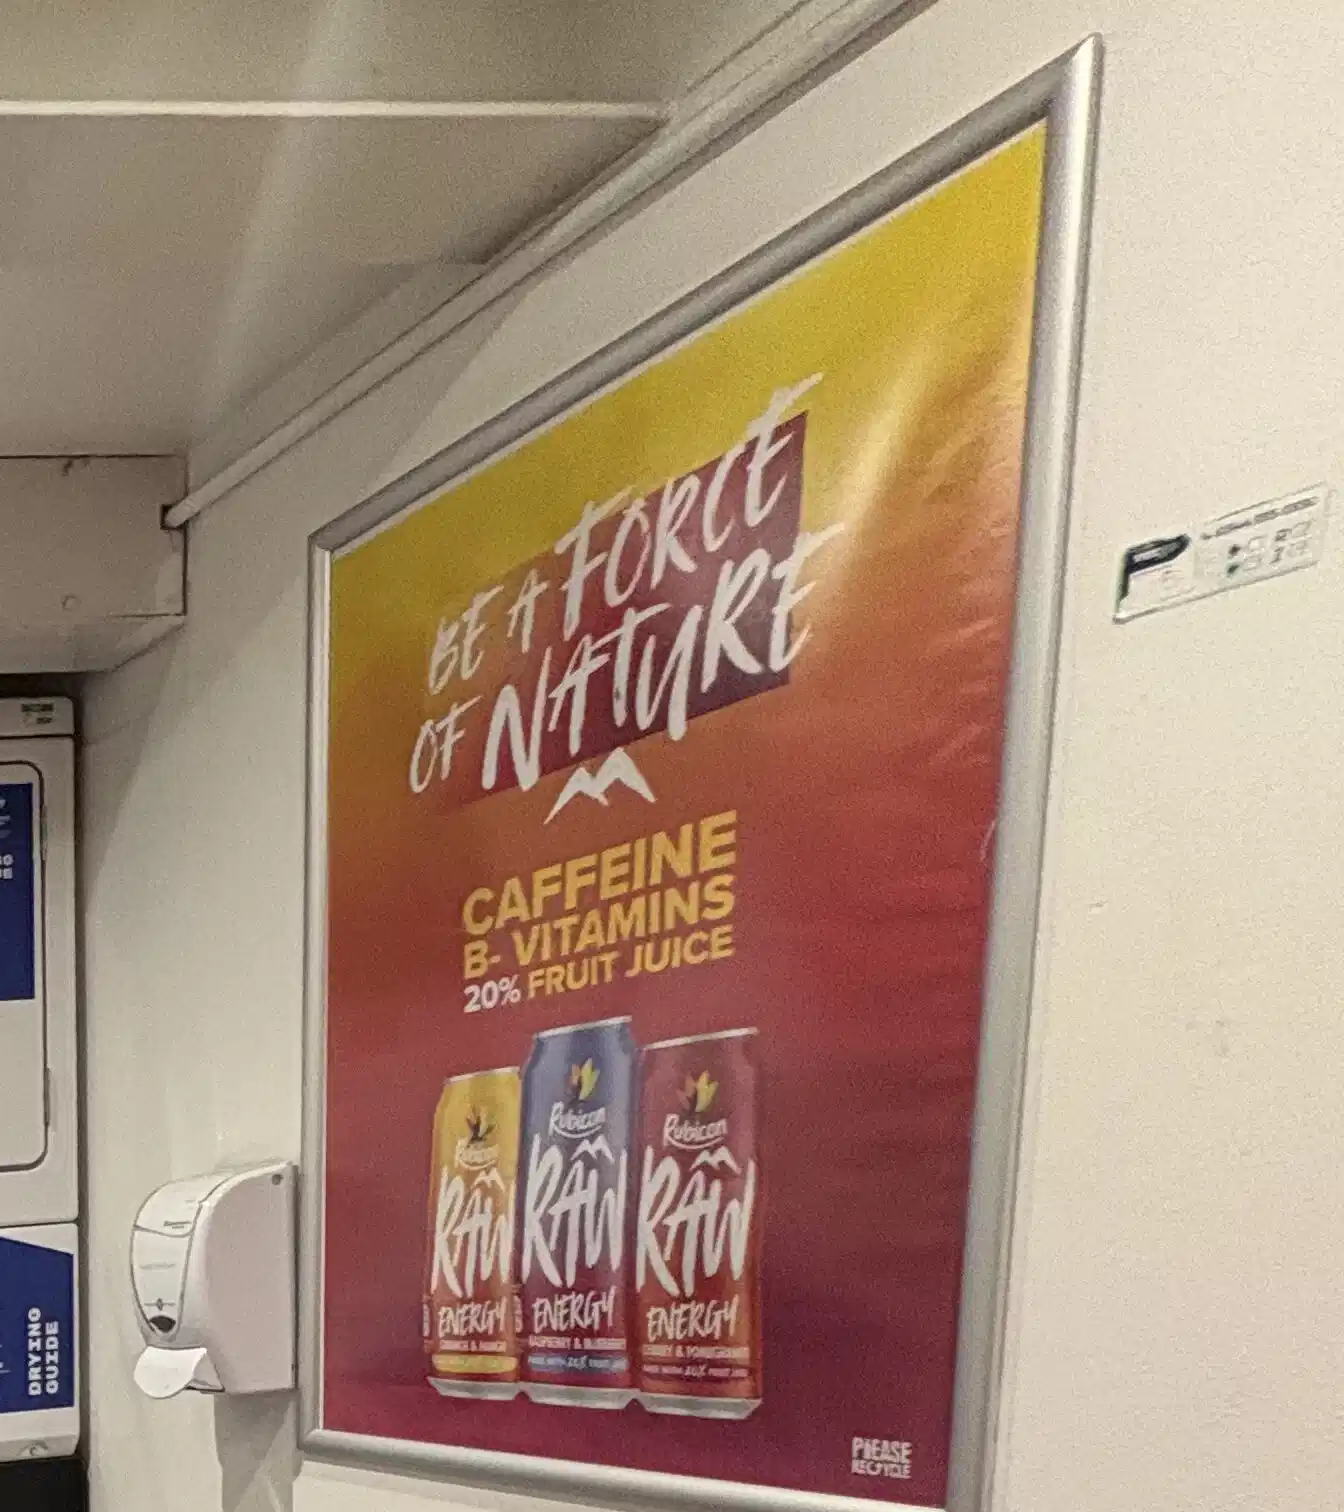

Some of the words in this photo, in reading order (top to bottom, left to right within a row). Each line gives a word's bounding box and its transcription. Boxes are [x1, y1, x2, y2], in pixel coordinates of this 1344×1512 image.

[429, 585, 503, 695] BE
[507, 569, 549, 653] A
[555, 374, 822, 641] FORCE
[411, 696, 481, 793] OF
[482, 522, 845, 791] NATURE
[463, 809, 737, 935] CAFFEINE
[512, 874, 735, 966] VITAMINS
[463, 975, 521, 1013] 20%
[528, 952, 620, 999] FRUIT
[624, 924, 734, 977] JUICE
[663, 1113, 727, 1149] Rubicon
[431, 1166, 516, 1299] RAW
[522, 1135, 628, 1288] RAW
[636, 1146, 756, 1296] RAW
[28, 1307, 42, 1396] DRYING
[438, 1296, 507, 1338] ENERGY
[532, 1286, 617, 1333] ENERGY
[646, 1294, 740, 1343] ENERGY
[45, 1320, 59, 1395] GUIDE
[852, 1436, 912, 1463] PLEASE
[852, 1459, 912, 1479] RECYCLE
